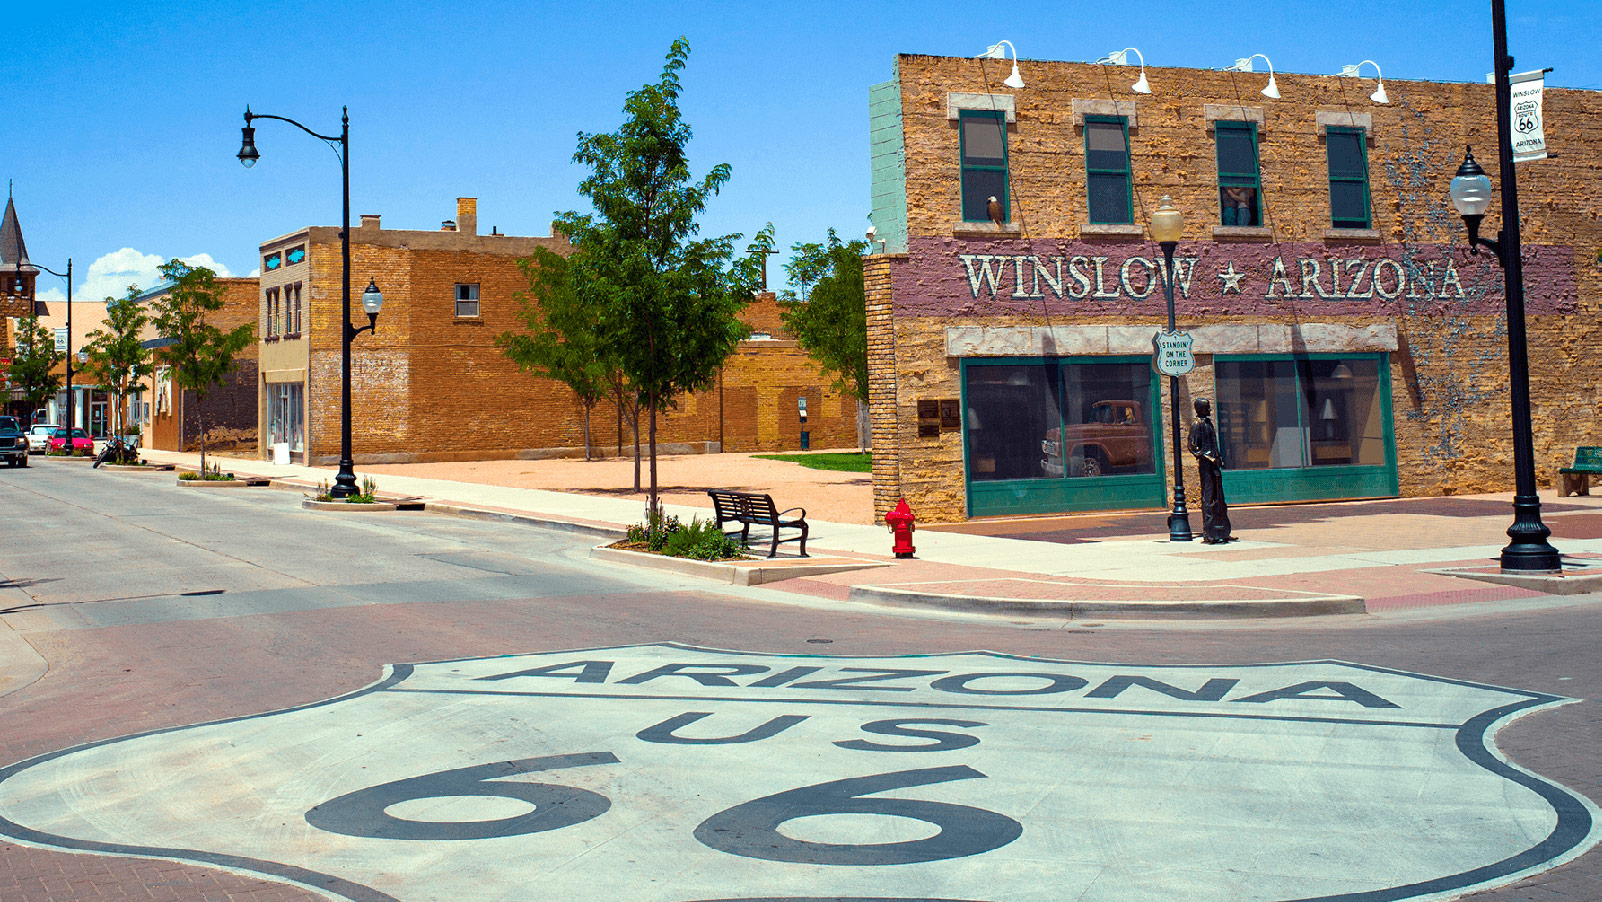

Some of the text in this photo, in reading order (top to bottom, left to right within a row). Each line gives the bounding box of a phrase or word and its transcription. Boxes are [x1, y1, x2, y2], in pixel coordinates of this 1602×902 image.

[1513, 89, 1540, 98] WINSLOW
[1516, 138, 1542, 148] ARIZONA
[1520, 118, 1534, 130] 66
[957, 254, 1466, 301] WINSLOW ARIZONA
[472, 660, 1405, 709] ARIZONA
[635, 711, 989, 753] US
[305, 752, 1023, 866] 66
